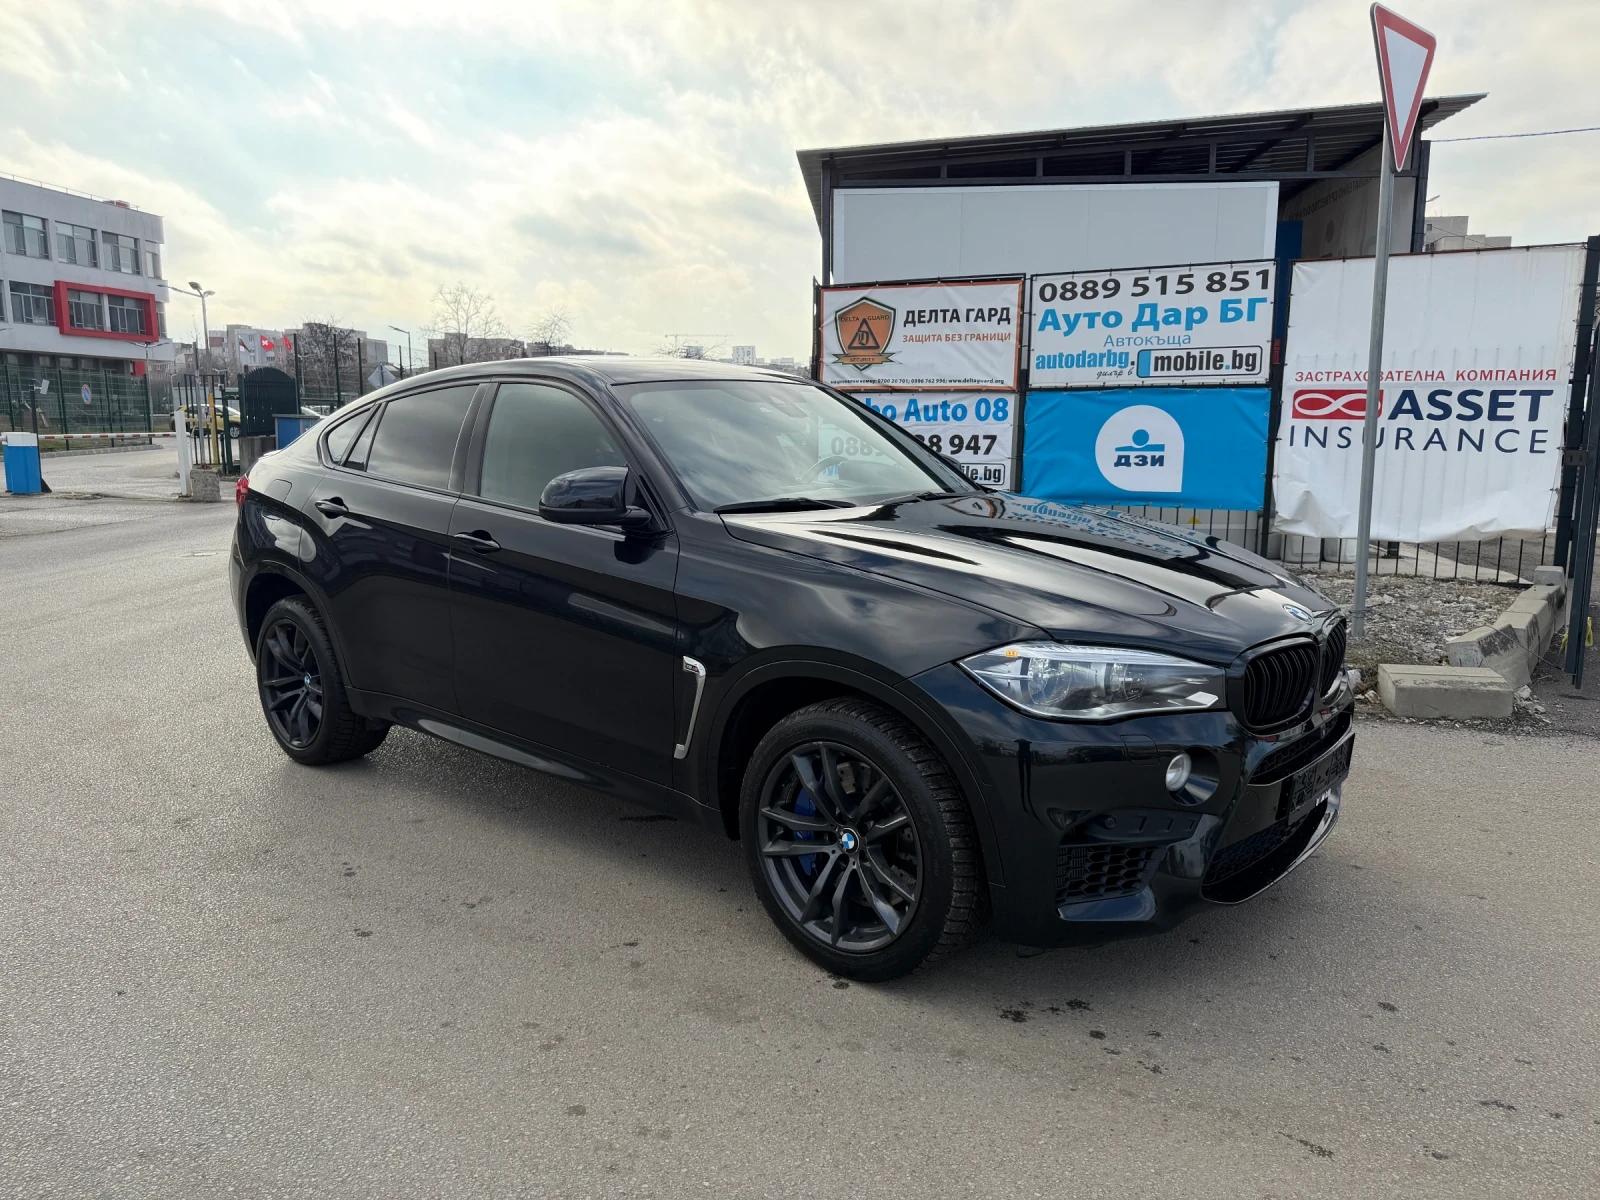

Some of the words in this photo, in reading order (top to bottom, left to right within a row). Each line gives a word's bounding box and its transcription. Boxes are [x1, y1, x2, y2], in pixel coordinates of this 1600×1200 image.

[1039, 278, 1121, 303] 0889
[1131, 273, 1195, 297] 515
[1205, 269, 1270, 293] 851
[903, 308, 962, 327] ДЕЛТА
[965, 307, 1011, 325] ГАРД
[1037, 308, 1123, 337] Ауто
[1131, 302, 1209, 333] Дар
[1219, 297, 1268, 323] БГ
[902, 334, 943, 344] ЗАЩИТА
[945, 333, 962, 342] БЕЗ
[964, 332, 1012, 342] ГРАНИЦИ
[1103, 334, 1191, 348] Автокъща
[1153, 350, 1258, 372] mobile.bg
[1456, 369, 1557, 381] КОМПАНИЯ
[904, 398, 968, 422] Auto
[975, 397, 1009, 422] 08
[1387, 389, 1554, 422] ASSET
[949, 434, 998, 455] 947
[1289, 425, 1549, 453] INSURANCE
[961, 465, 1002, 483] ile.bg
